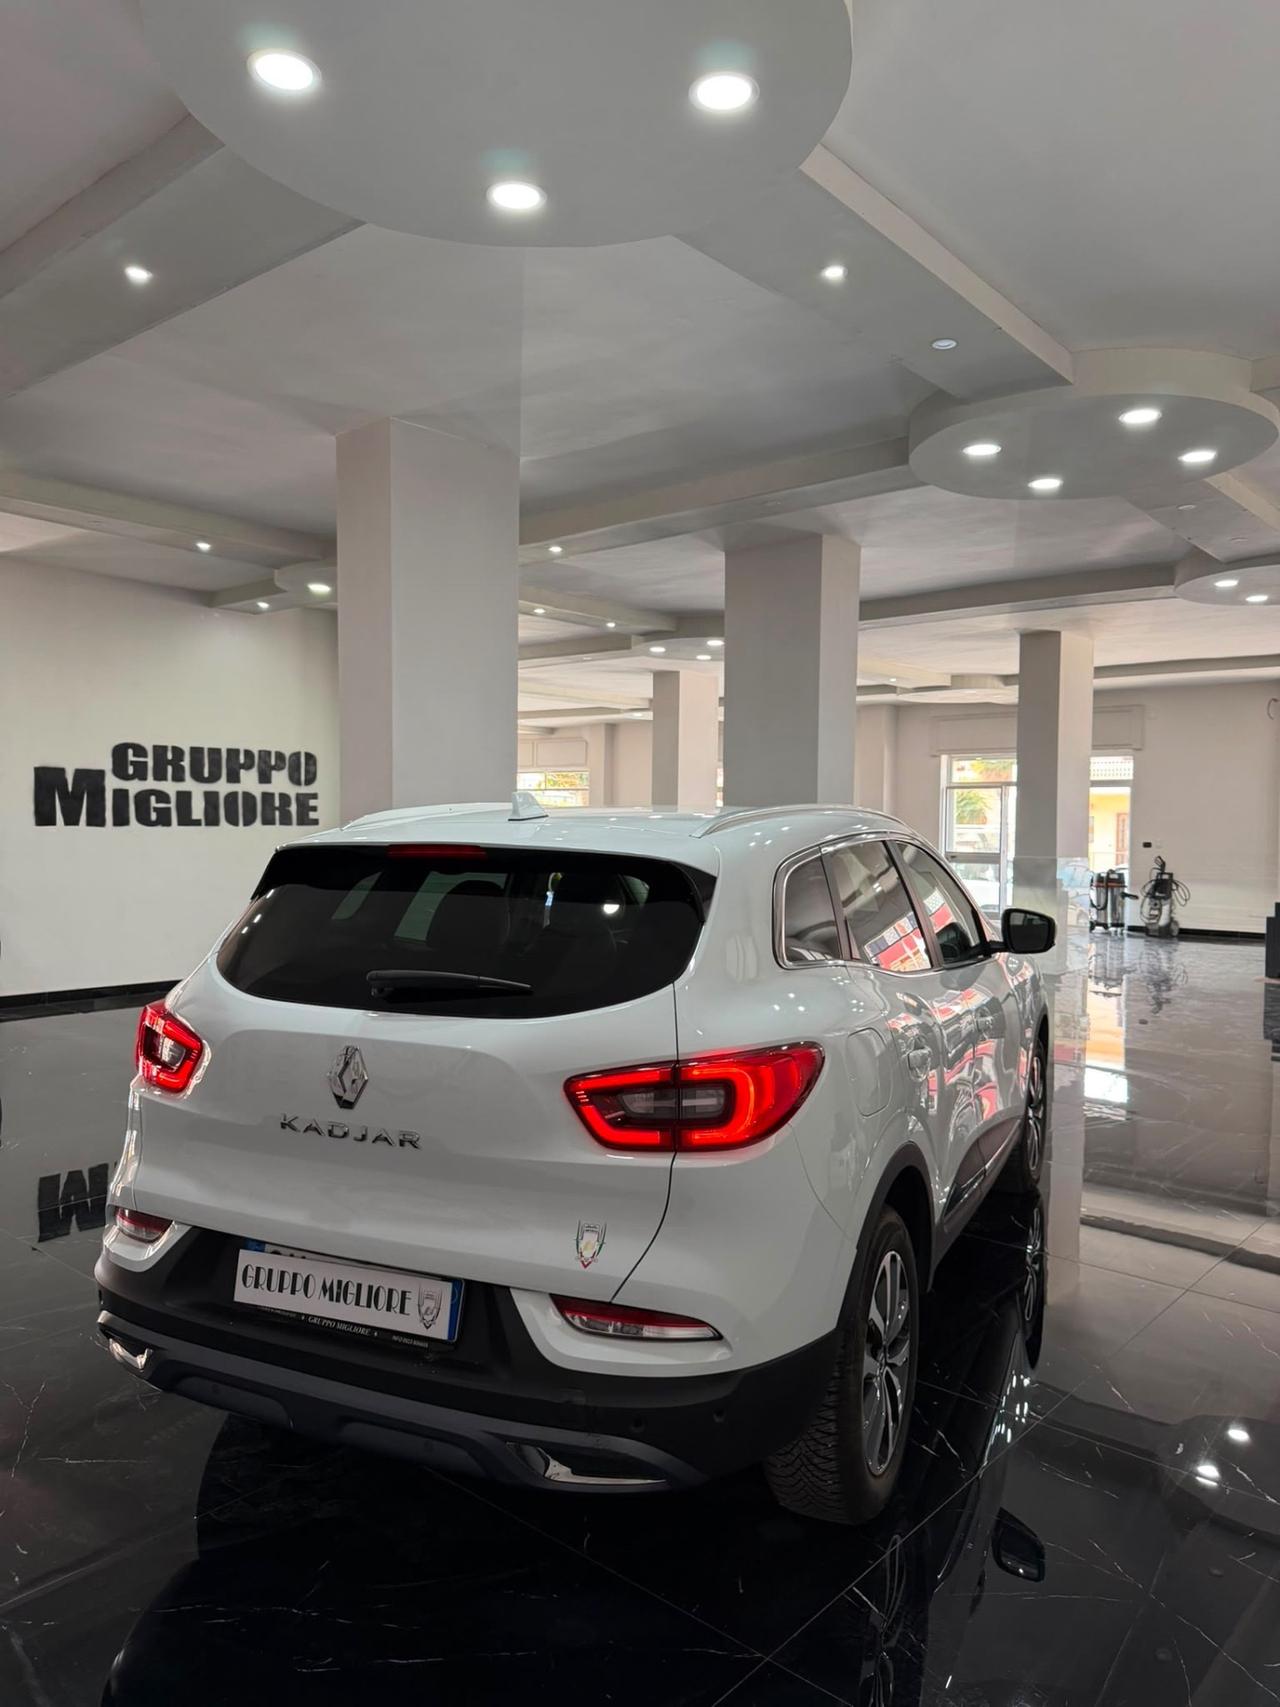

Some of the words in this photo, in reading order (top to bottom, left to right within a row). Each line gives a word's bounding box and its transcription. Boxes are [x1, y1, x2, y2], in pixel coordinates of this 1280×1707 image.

[111, 742, 318, 786] GRUPPO
[33, 766, 319, 827] MIGLIORE
[280, 1114, 421, 1149] KADJAR
[241, 1264, 316, 1299] GRUPPO
[318, 1278, 412, 1316] MIGLIORE
[307, 1316, 335, 1329] GRUPPO
[336, 1323, 371, 1336] MIGLIORE
